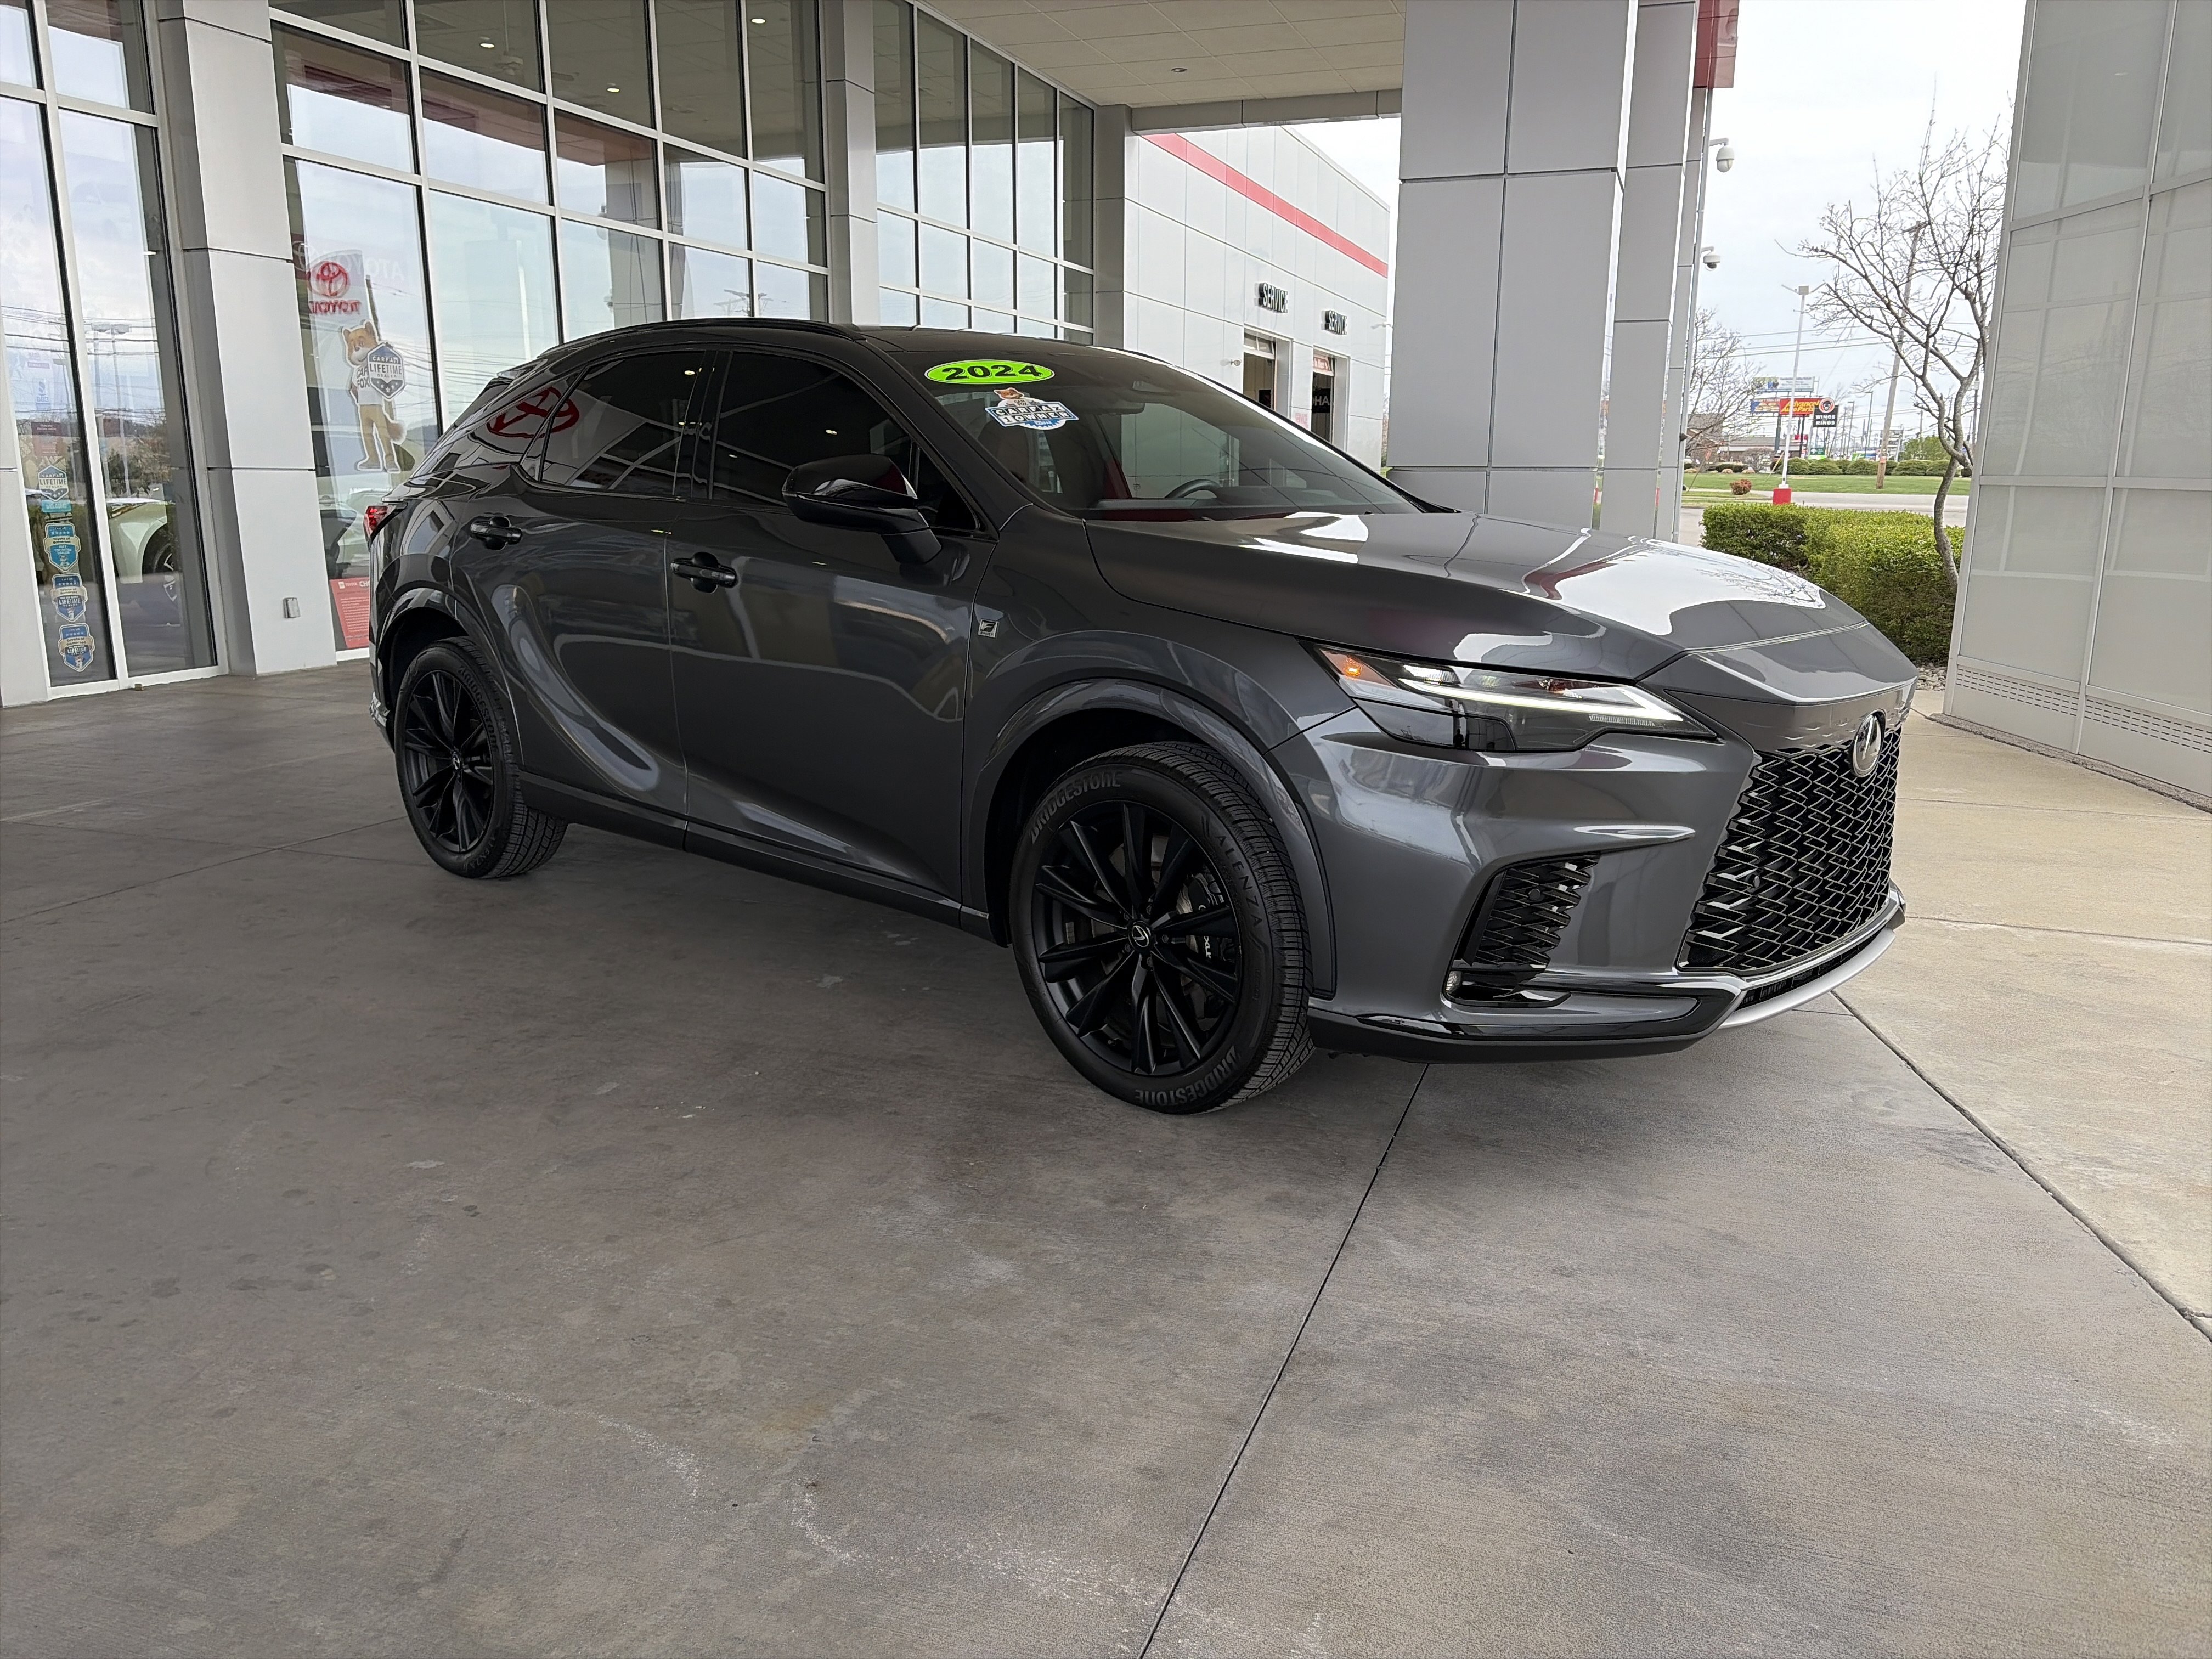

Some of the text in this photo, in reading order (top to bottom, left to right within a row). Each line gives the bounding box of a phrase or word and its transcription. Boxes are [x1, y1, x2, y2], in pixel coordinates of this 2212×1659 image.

[1260, 282, 1289, 313] SERVICE
[1327, 309, 1348, 335] SERVICE
[369, 363, 402, 374] LIFETIME
[942, 364, 1042, 381] 2024
[357, 377, 370, 388] FOX
[995, 405, 1063, 415] CARFAX
[1015, 411, 1070, 421] OWNER
[1030, 771, 1123, 845] BRIDGESTONE
[1215, 834, 1263, 928] ALENZA
[1134, 1045, 1242, 1107] BRIDGESTONE
